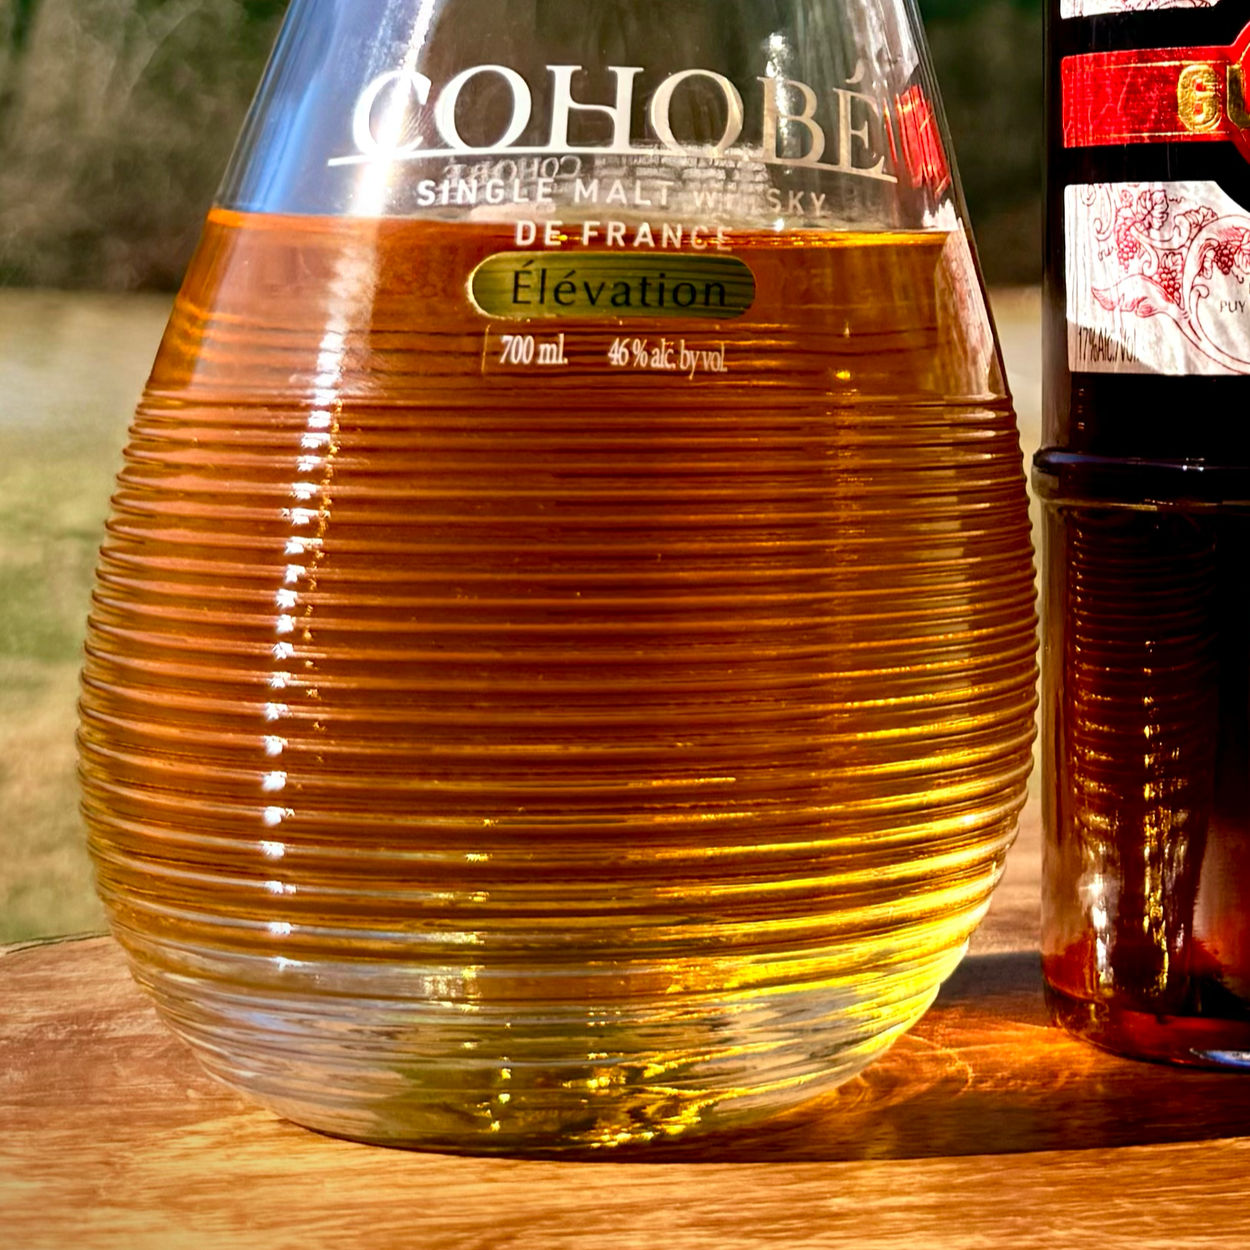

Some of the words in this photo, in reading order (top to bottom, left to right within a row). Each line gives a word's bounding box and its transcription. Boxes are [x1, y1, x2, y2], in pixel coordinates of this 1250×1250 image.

[352, 64, 888, 178] COHOBÉ
[417, 178, 555, 206] SINGLE
[574, 177, 675, 206] MALT
[516, 220, 563, 246] DE
[583, 220, 733, 252] FRANCE
[512, 259, 726, 307] Élévation
[1219, 300, 1245, 313] PUY
[499, 334, 535, 365] 700
[537, 333, 569, 365] ml.
[680, 339, 701, 380] by
[701, 341, 729, 372] vol.
